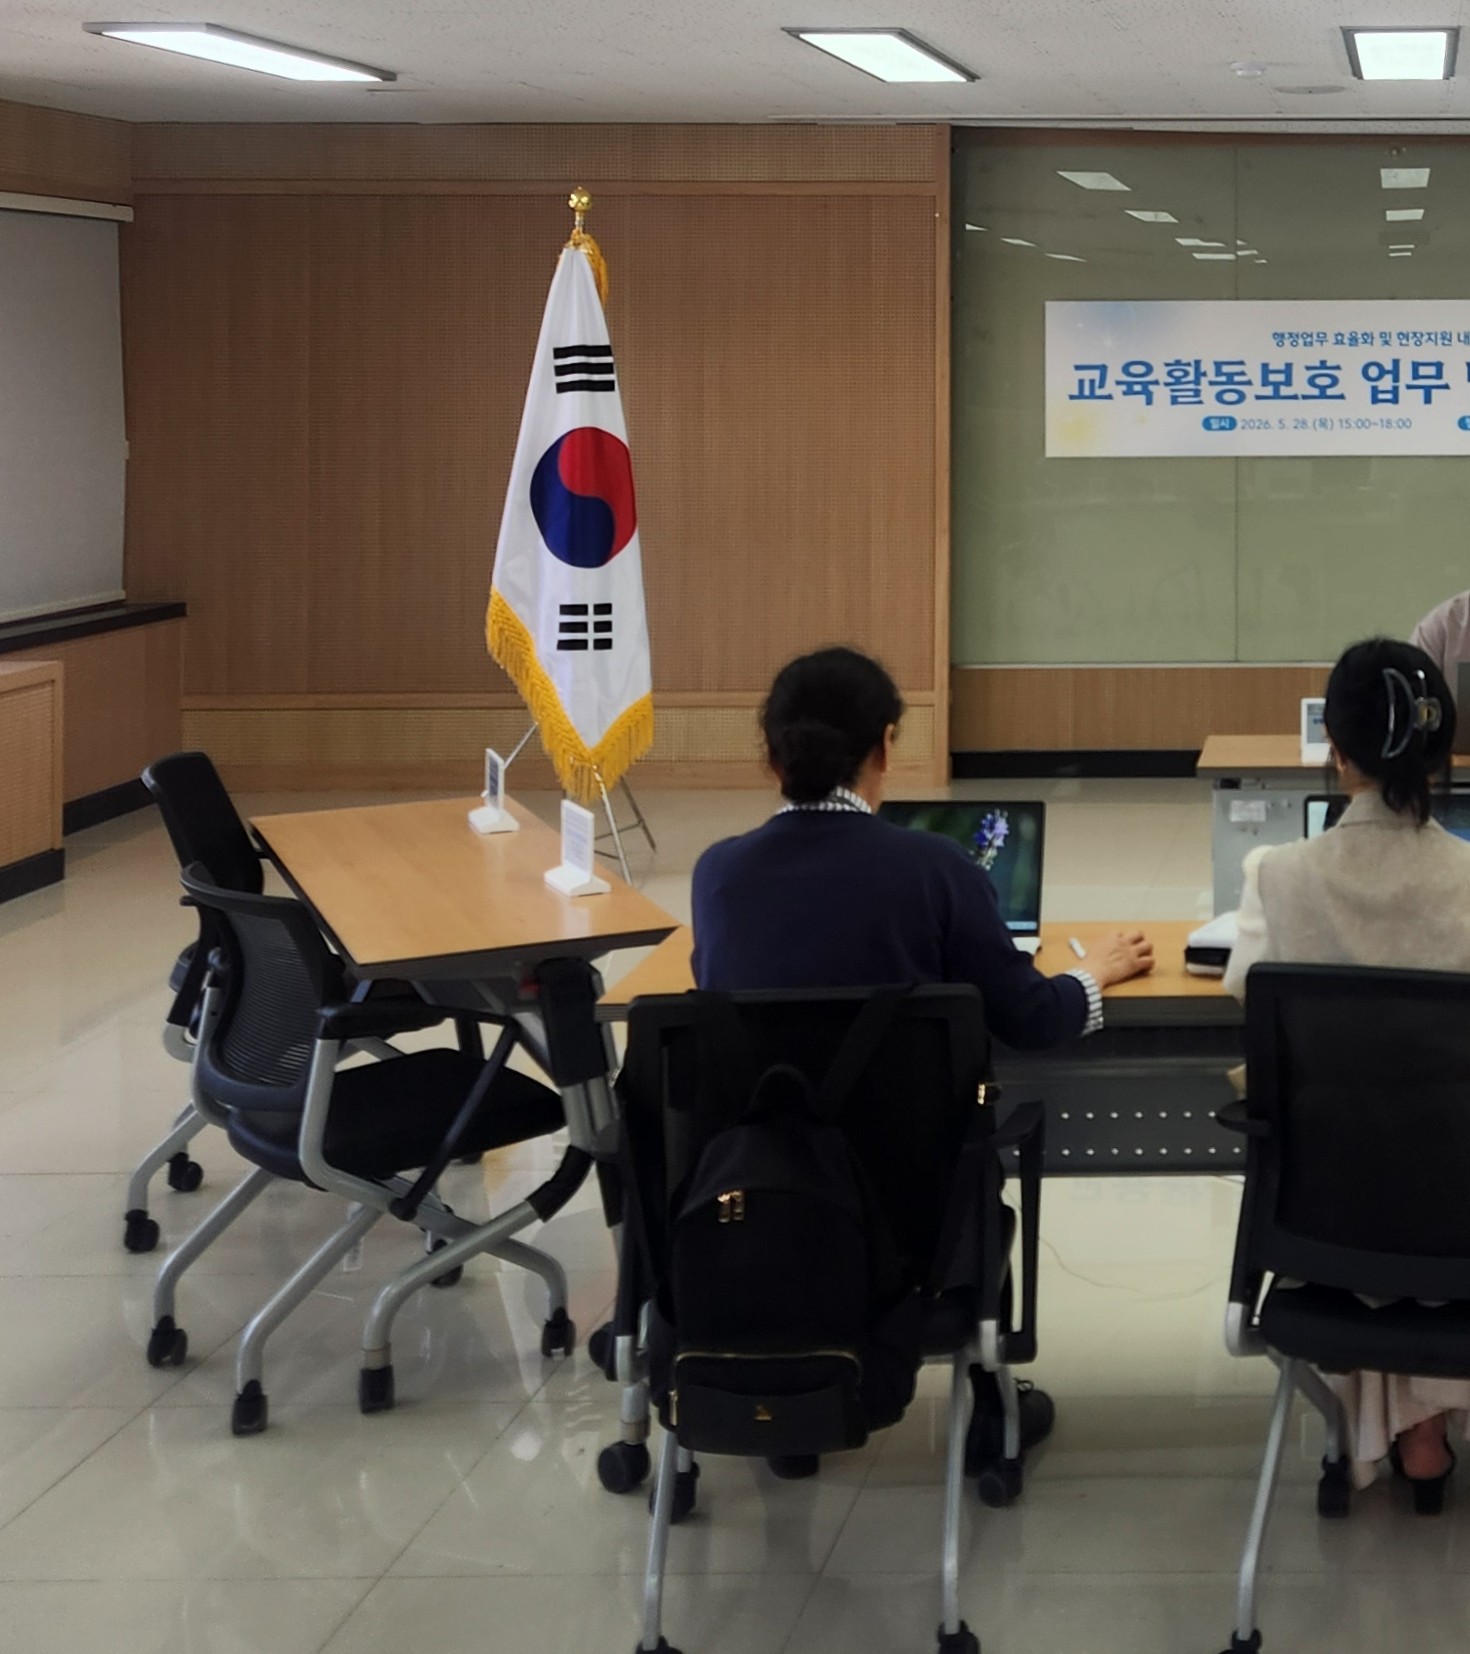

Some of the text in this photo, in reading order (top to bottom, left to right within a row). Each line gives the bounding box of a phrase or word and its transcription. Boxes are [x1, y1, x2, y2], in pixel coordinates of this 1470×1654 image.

[1272, 331, 1329, 348] 행정업무
[1333, 331, 1375, 347] 효율화
[1379, 331, 1392, 347] 및
[1396, 331, 1452, 347] 현장지원
[1068, 359, 1346, 406] 교육활동보호
[1361, 358, 1451, 405] 업무
[1208, 417, 1231, 430] 일시
[1241, 418, 1273, 430] 2026.
[1278, 418, 1288, 430] 5.
[1338, 418, 1412, 430] 15:00~18:00
